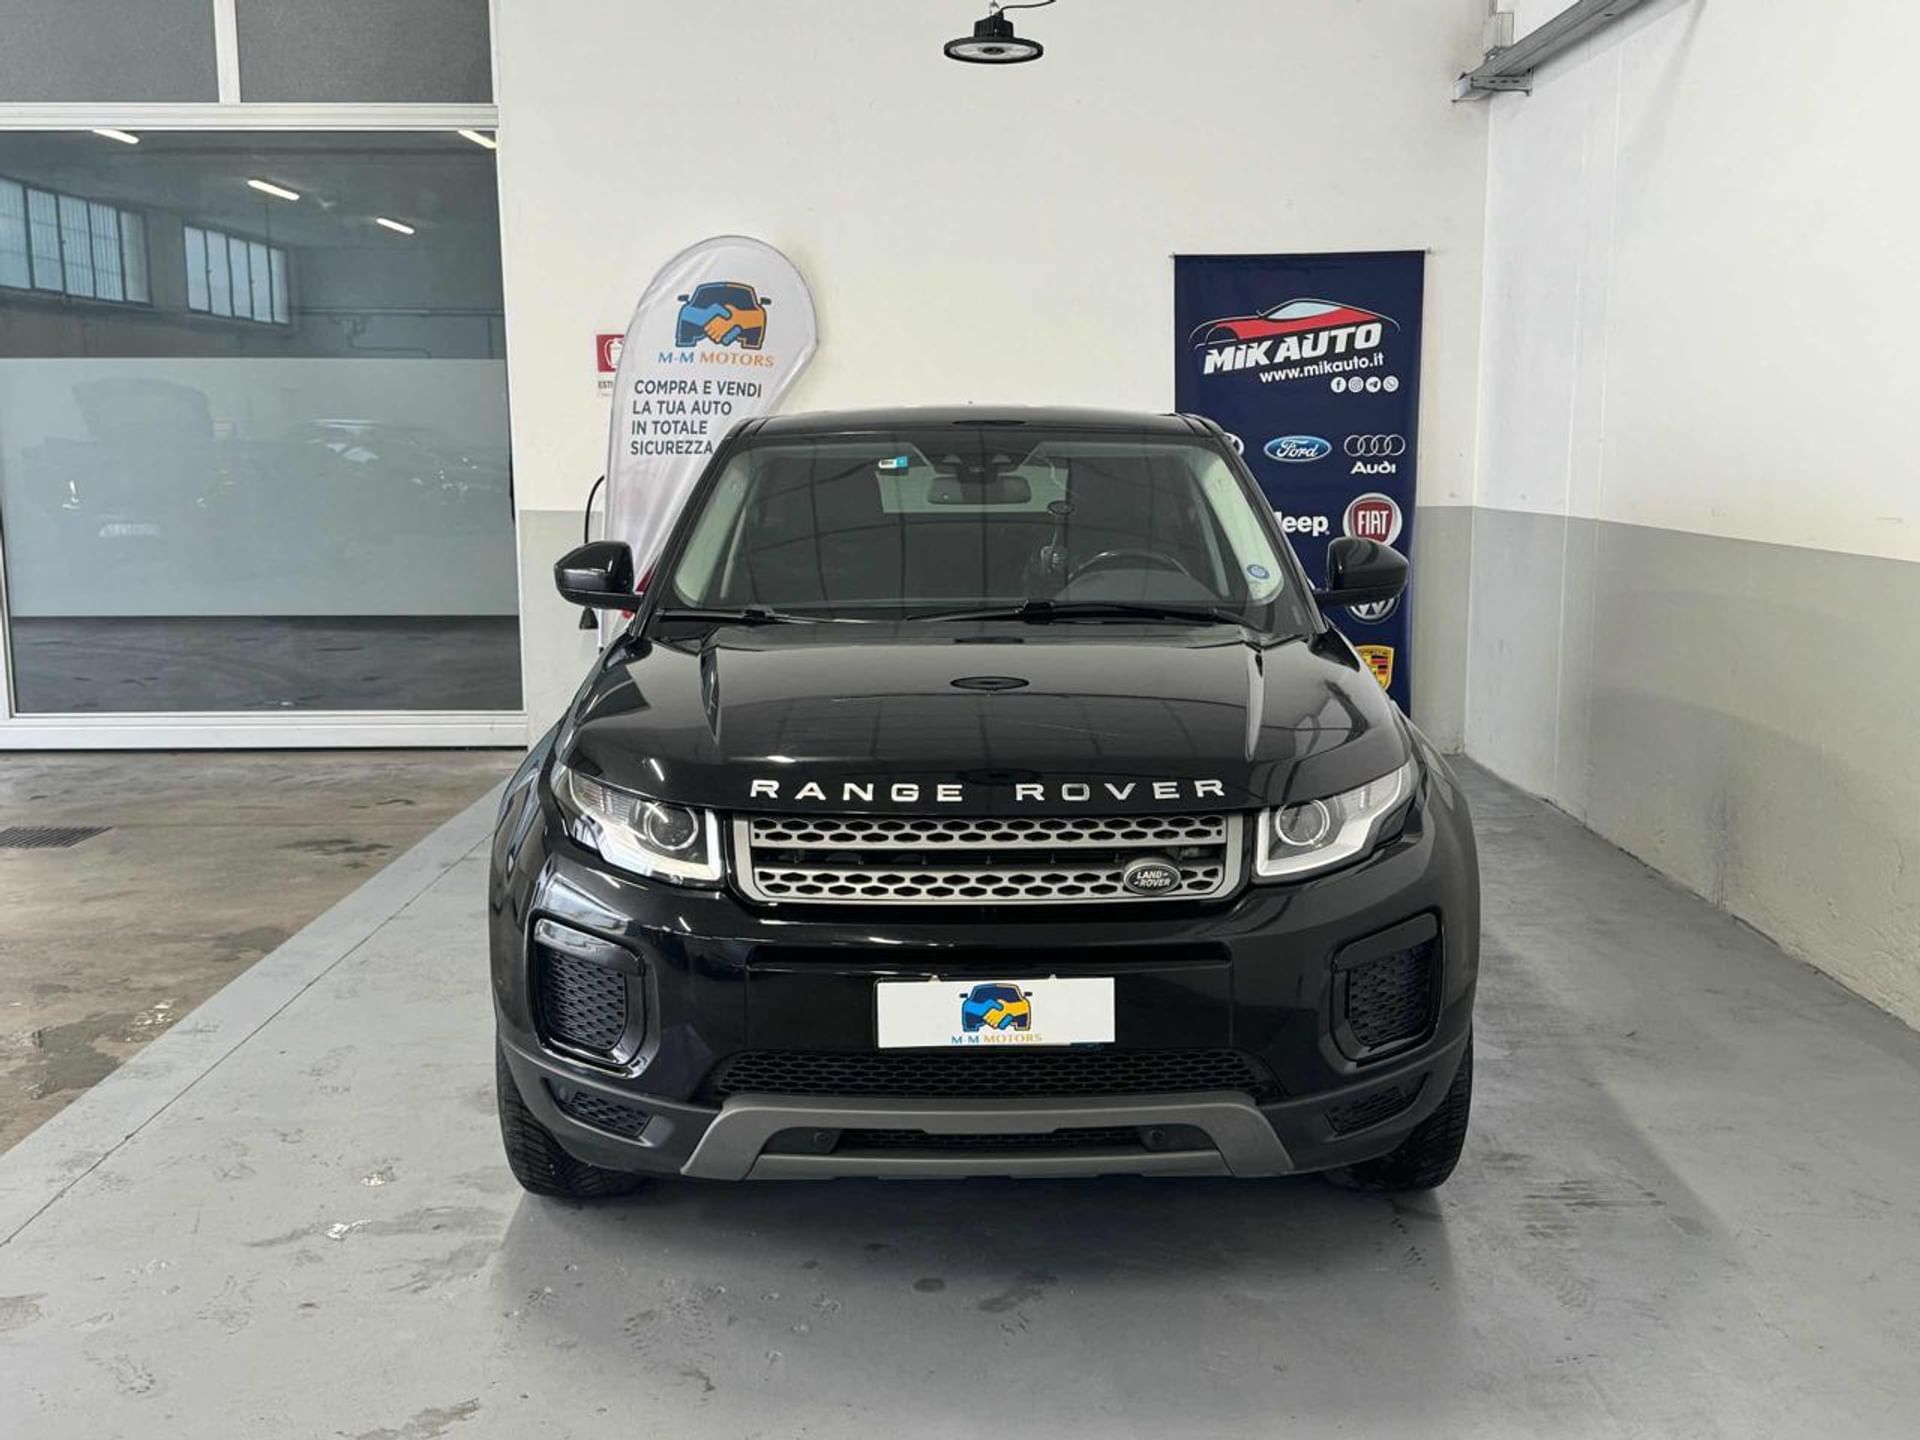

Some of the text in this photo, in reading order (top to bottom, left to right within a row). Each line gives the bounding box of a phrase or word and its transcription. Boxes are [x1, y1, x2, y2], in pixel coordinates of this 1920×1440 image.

[658, 352, 775, 367] M-M MOTORS
[1259, 352, 1385, 383] www.mikauto.it
[634, 380, 762, 398] COMPRA E VENDI
[632, 400, 732, 416] LA TUA AUTO
[631, 420, 708, 435] IN TOTALE
[630, 440, 714, 456] SICUREZZA
[1276, 439, 1319, 457] Ford
[1350, 461, 1396, 474] Audi
[1357, 510, 1389, 535] FIAT
[749, 779, 1226, 802] RANGE ROVER
[983, 1033, 1043, 1043] MOTORS
